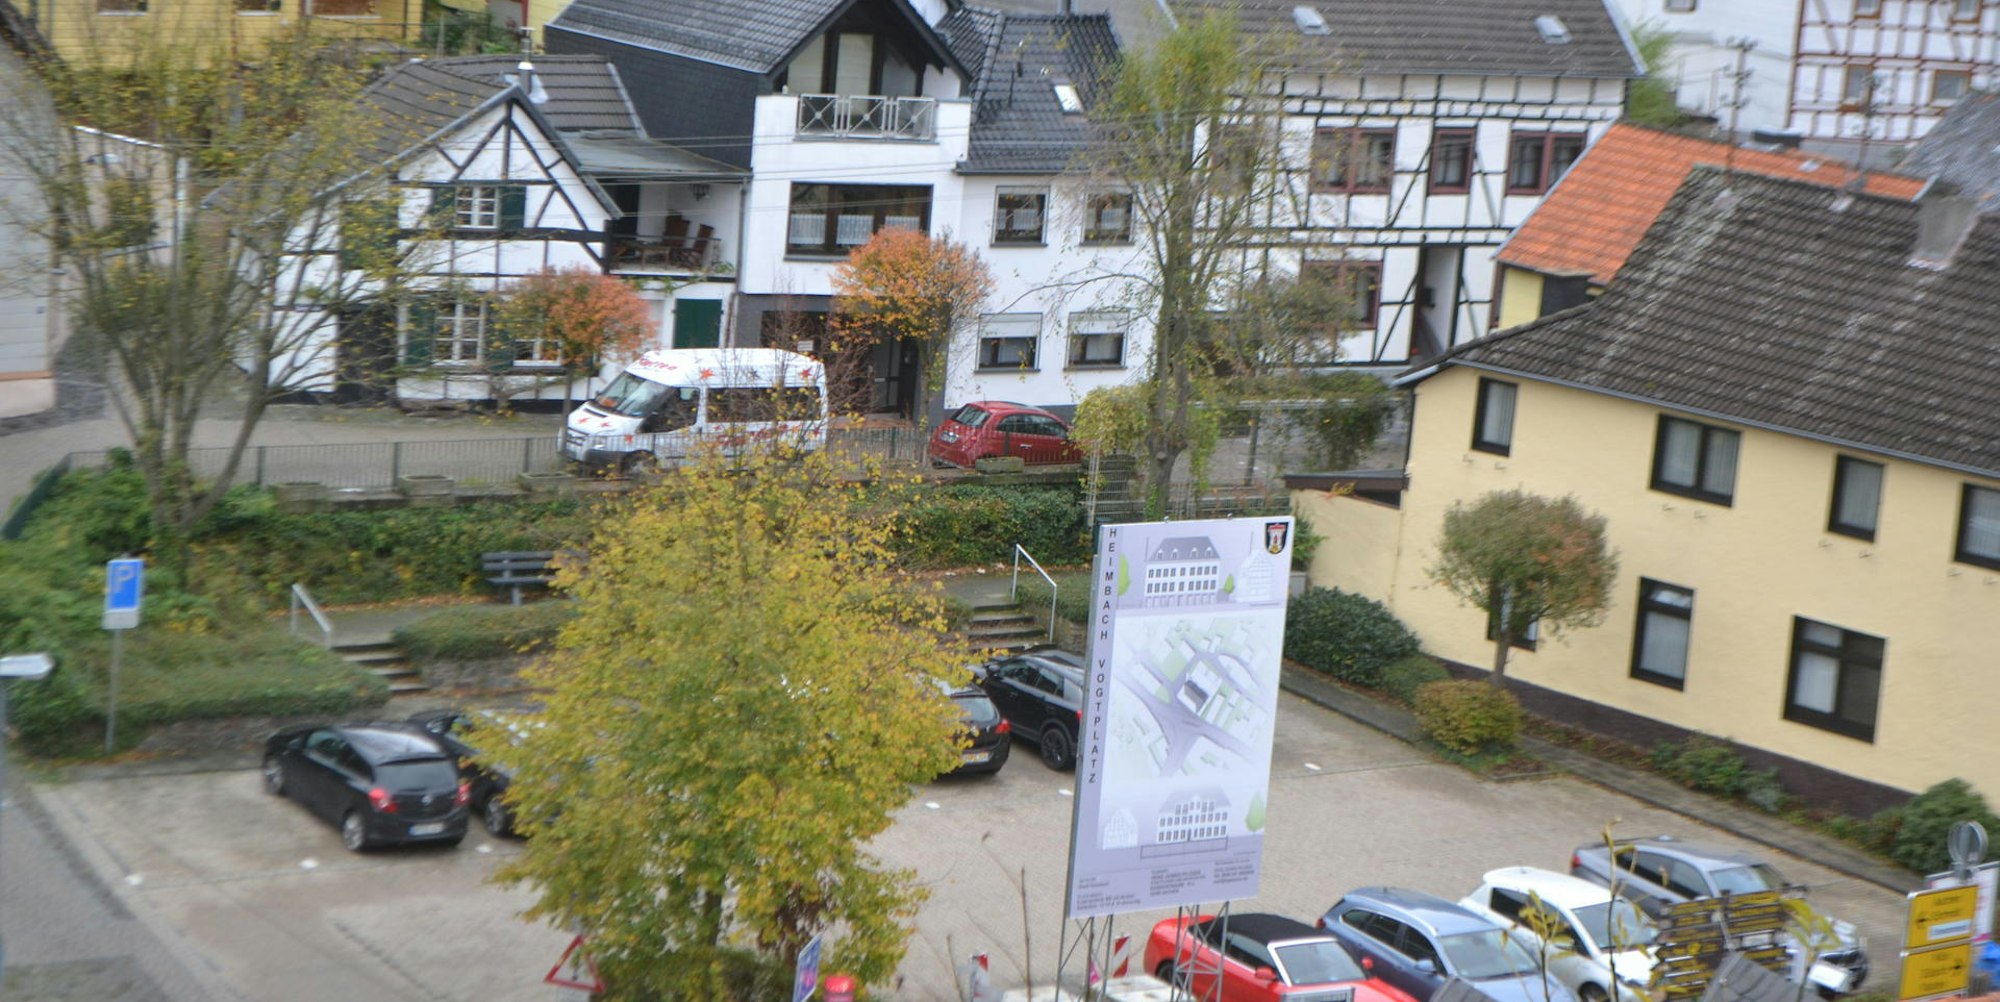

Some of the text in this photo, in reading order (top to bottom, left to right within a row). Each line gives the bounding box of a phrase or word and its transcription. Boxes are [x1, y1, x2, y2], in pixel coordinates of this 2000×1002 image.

[111, 565, 136, 594] P
[1088, 528, 1117, 784] HEIMBACH VOGTPLATZ
